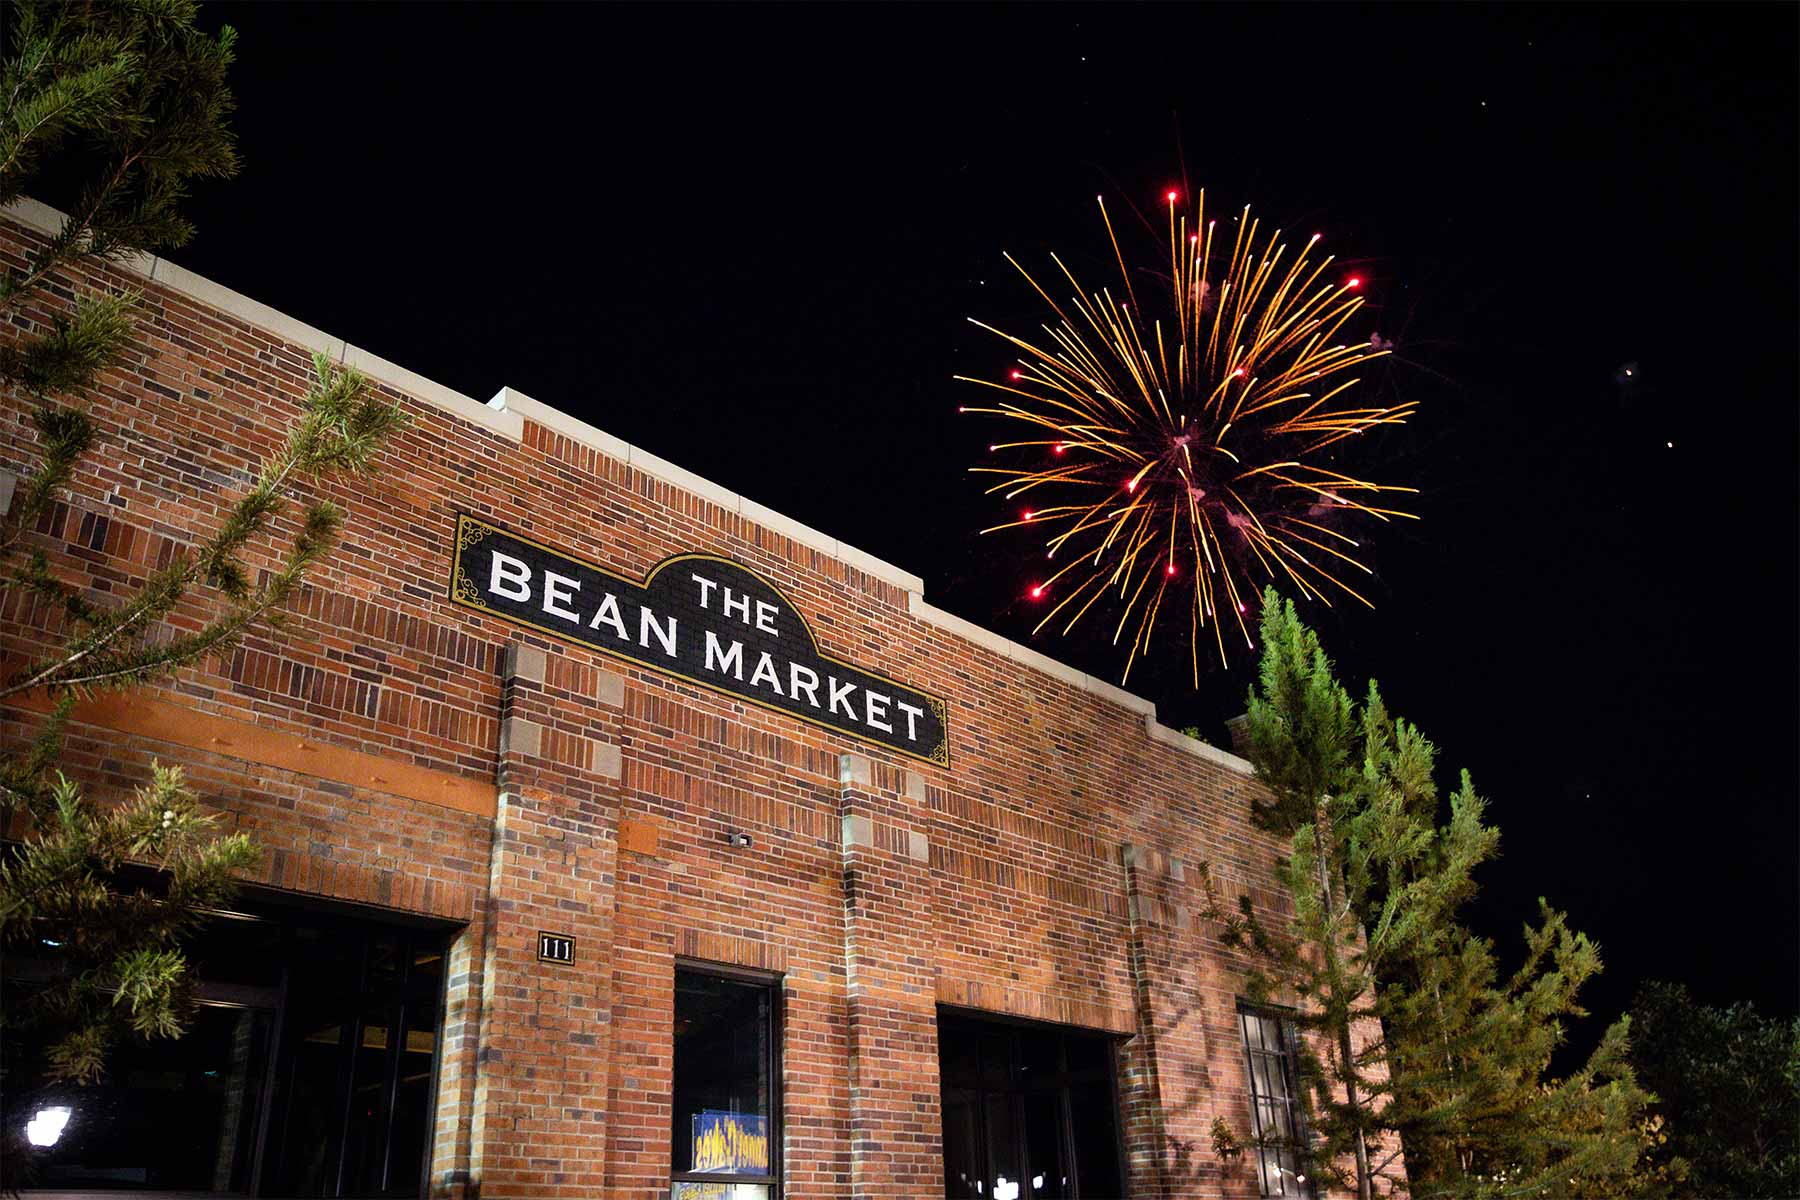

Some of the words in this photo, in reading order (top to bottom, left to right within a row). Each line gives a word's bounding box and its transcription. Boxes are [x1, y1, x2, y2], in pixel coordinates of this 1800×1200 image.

[691, 572, 780, 637] THE
[487, 549, 678, 658] BEAN
[704, 630, 924, 741] MARKET
[543, 937, 570, 960] 111
